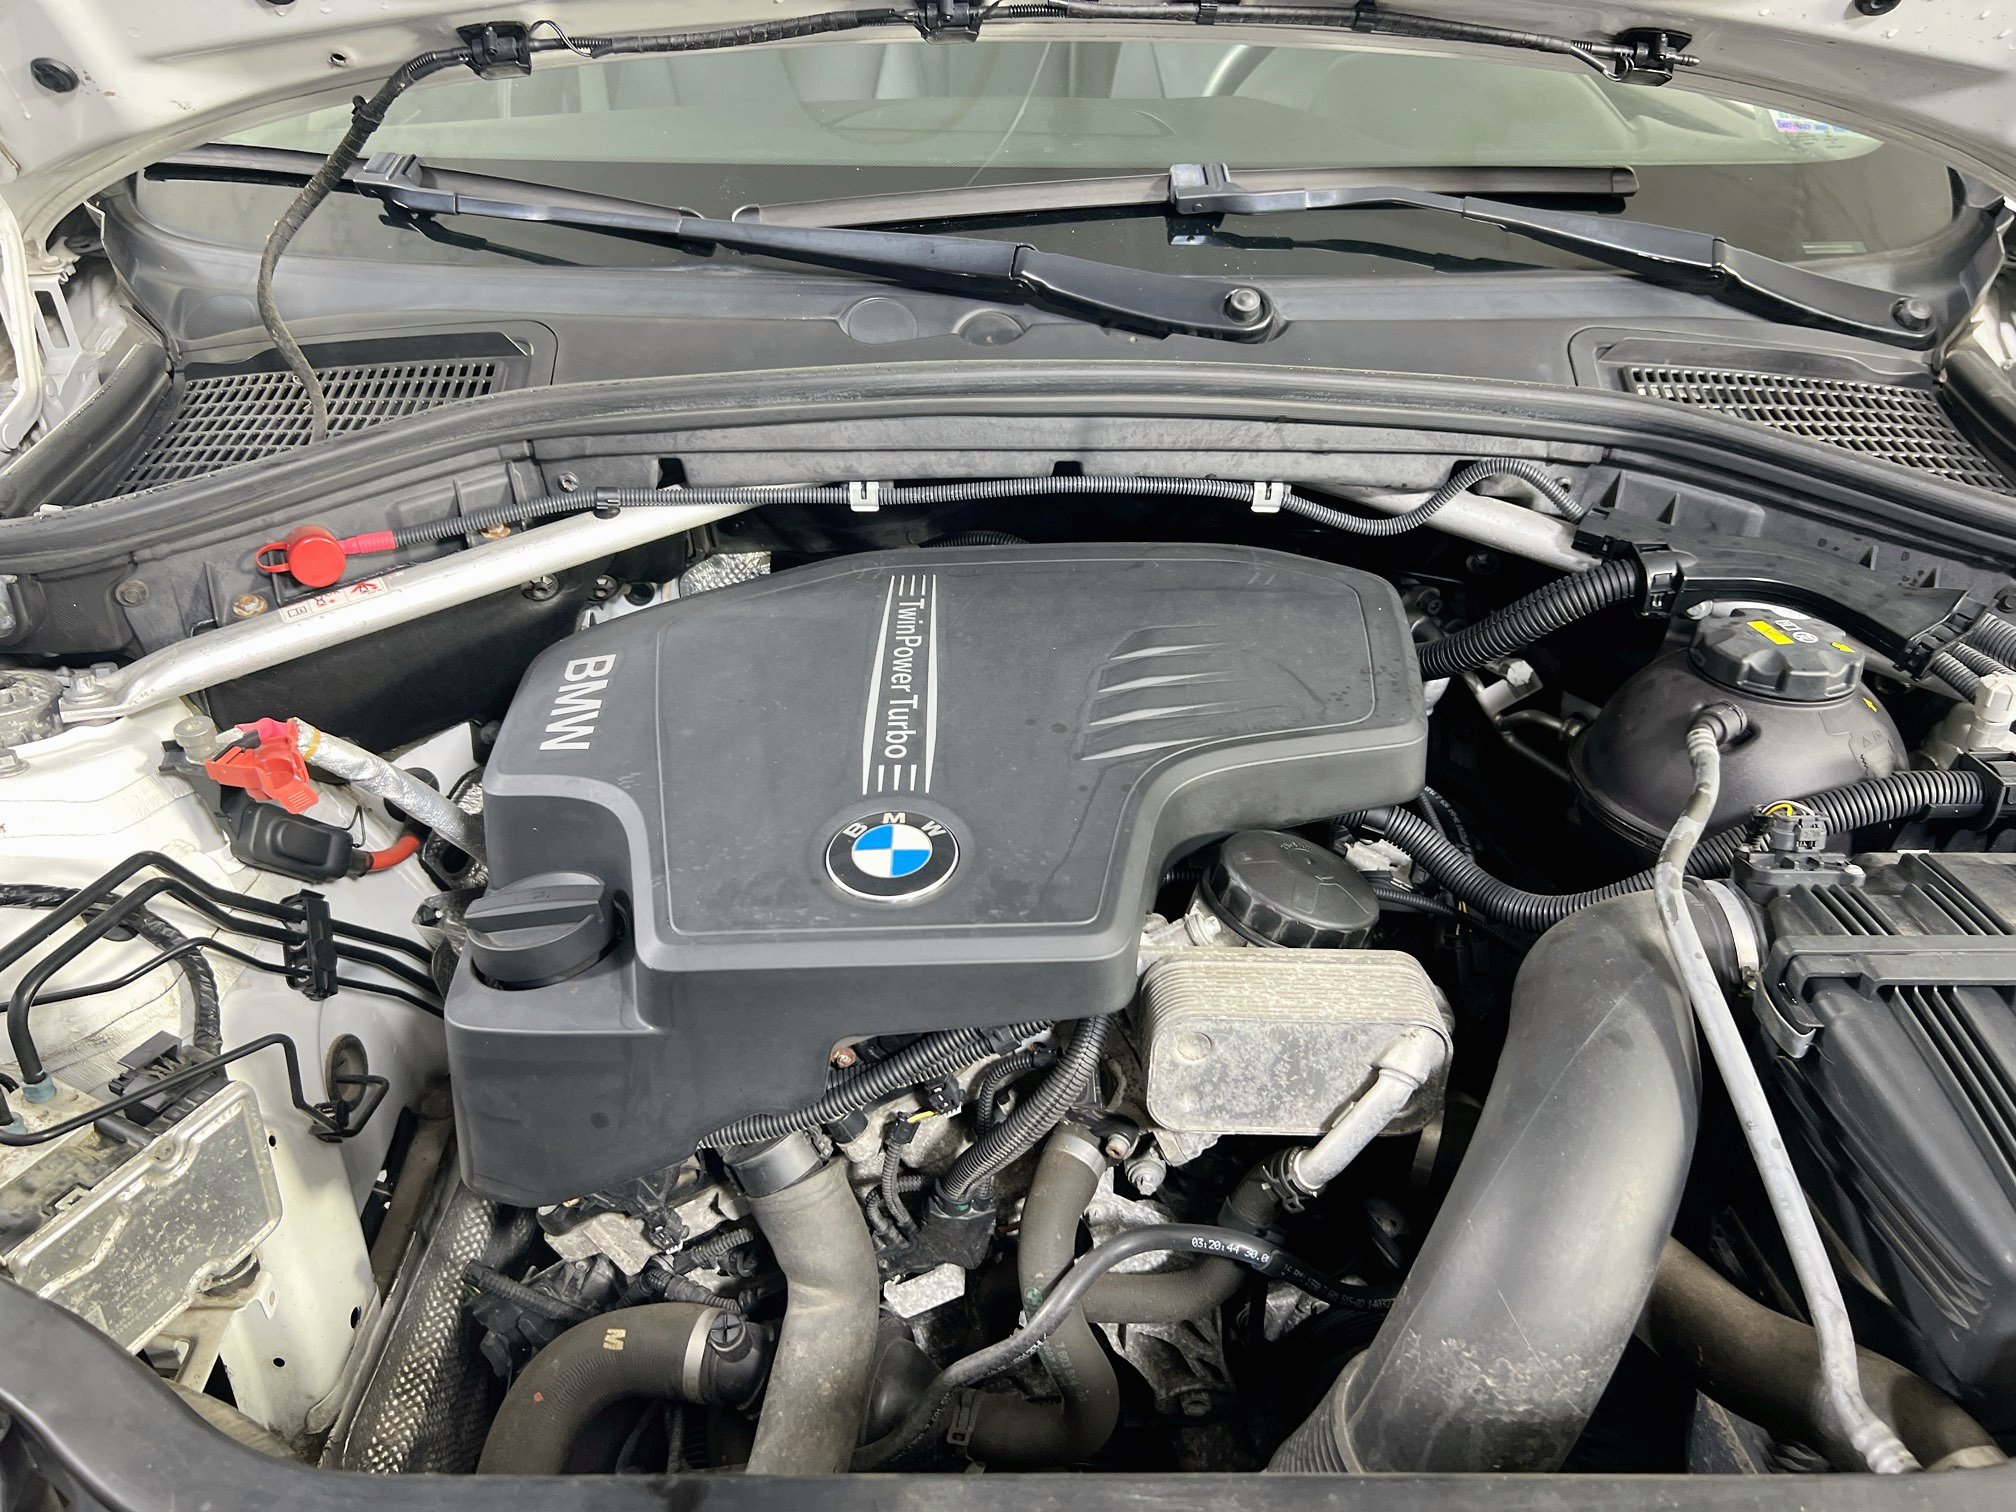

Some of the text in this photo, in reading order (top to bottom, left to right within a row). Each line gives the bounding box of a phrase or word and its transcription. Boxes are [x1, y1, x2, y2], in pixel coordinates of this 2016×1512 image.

[540, 653, 617, 751] BMW
[884, 598, 925, 759] TwinPower Turbo
[842, 812, 947, 839] BMW
[603, 1328, 627, 1351] M
